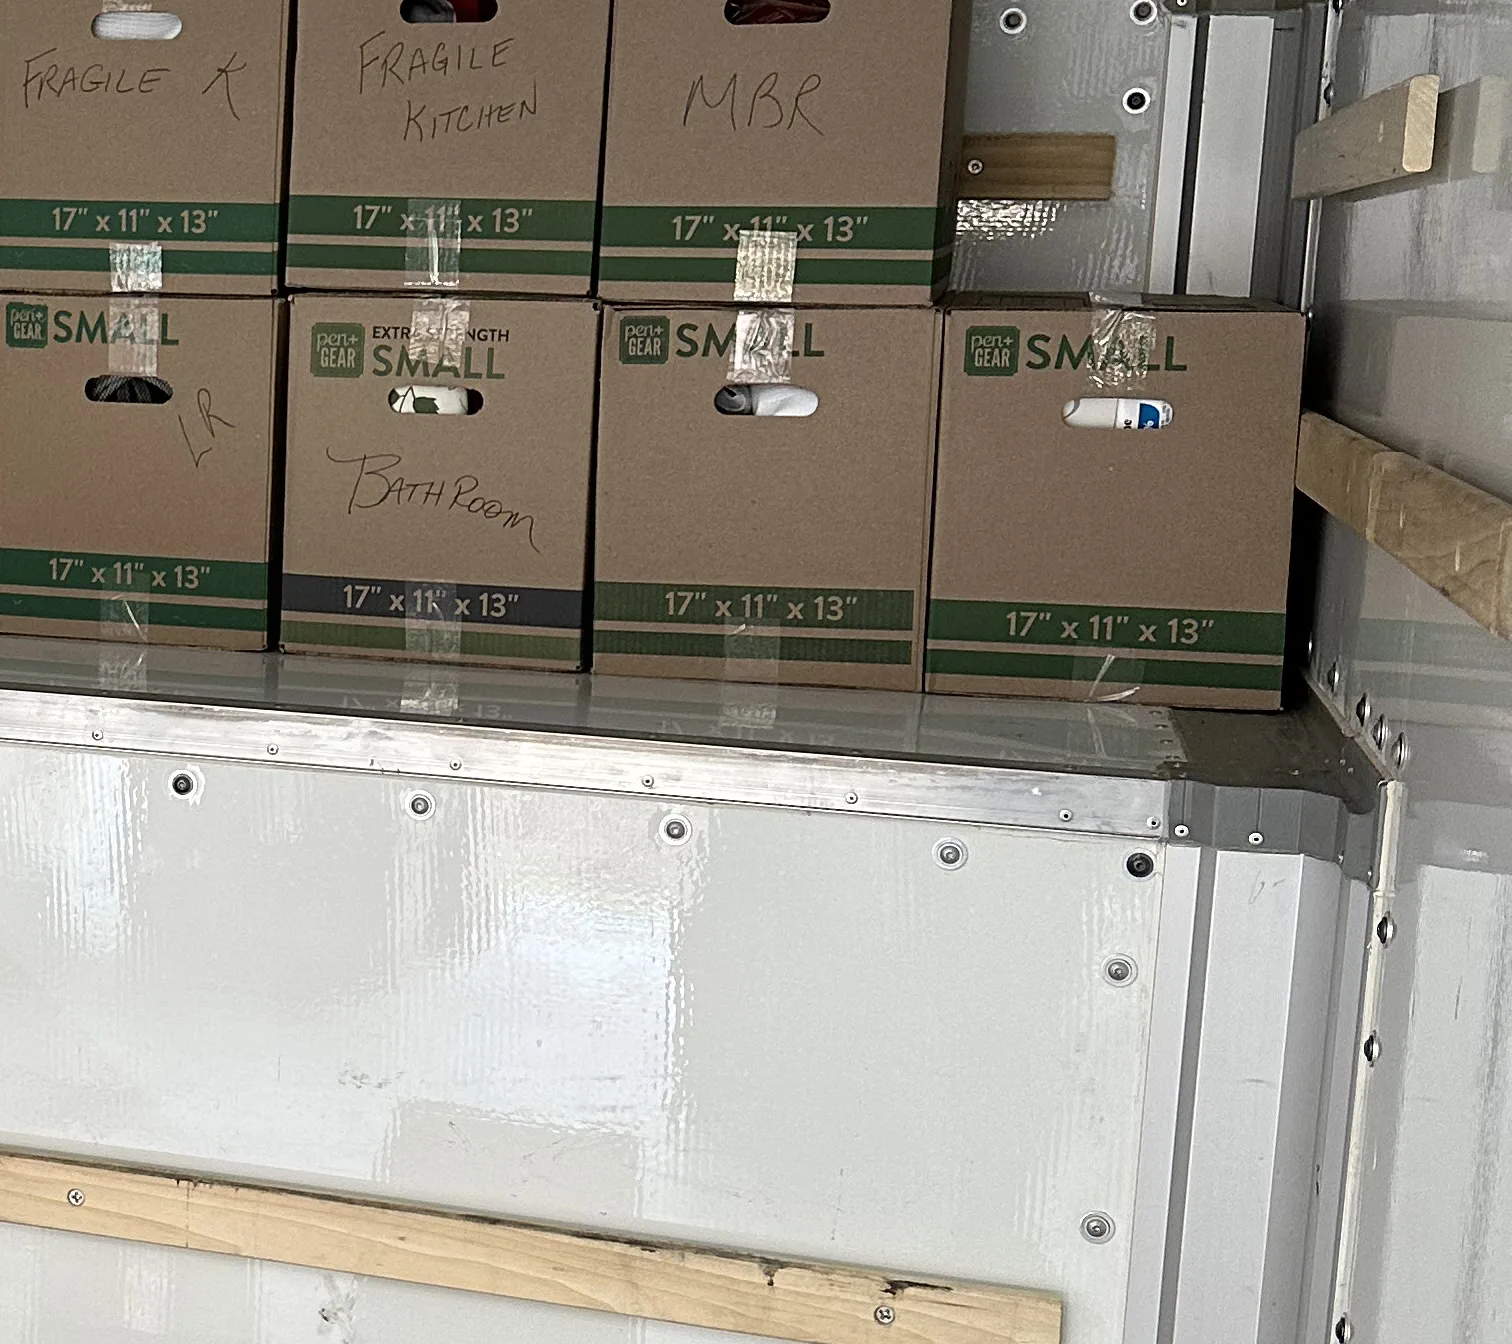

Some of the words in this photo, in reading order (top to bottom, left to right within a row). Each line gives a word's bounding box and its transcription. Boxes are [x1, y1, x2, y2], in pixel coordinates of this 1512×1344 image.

[22, 48, 171, 108] FRAGILE
[359, 30, 515, 94] FRAGILE
[403, 80, 537, 142] KITCHEN
[684, 72, 823, 136] MBR
[52, 207, 88, 231] 17"
[95, 215, 111, 232] x
[118, 208, 150, 232] 11"
[157, 216, 173, 233] x
[180, 209, 219, 234] 13"
[372, 326, 415, 340] EXTR
[675, 322, 825, 357] SML
[320, 348, 356, 369] GEAR
[372, 345, 505, 379] SMALL
[665, 592, 706, 616] 17"
[715, 600, 733, 617] x
[741, 593, 778, 618] 11"
[787, 602, 804, 619] x
[814, 596, 858, 621] 13"
[1006, 612, 1052, 636] 17"
[1061, 622, 1078, 639] x
[1089, 615, 1129, 641] 11"
[1138, 625, 1156, 643] x
[1168, 618, 1215, 644] 13"
